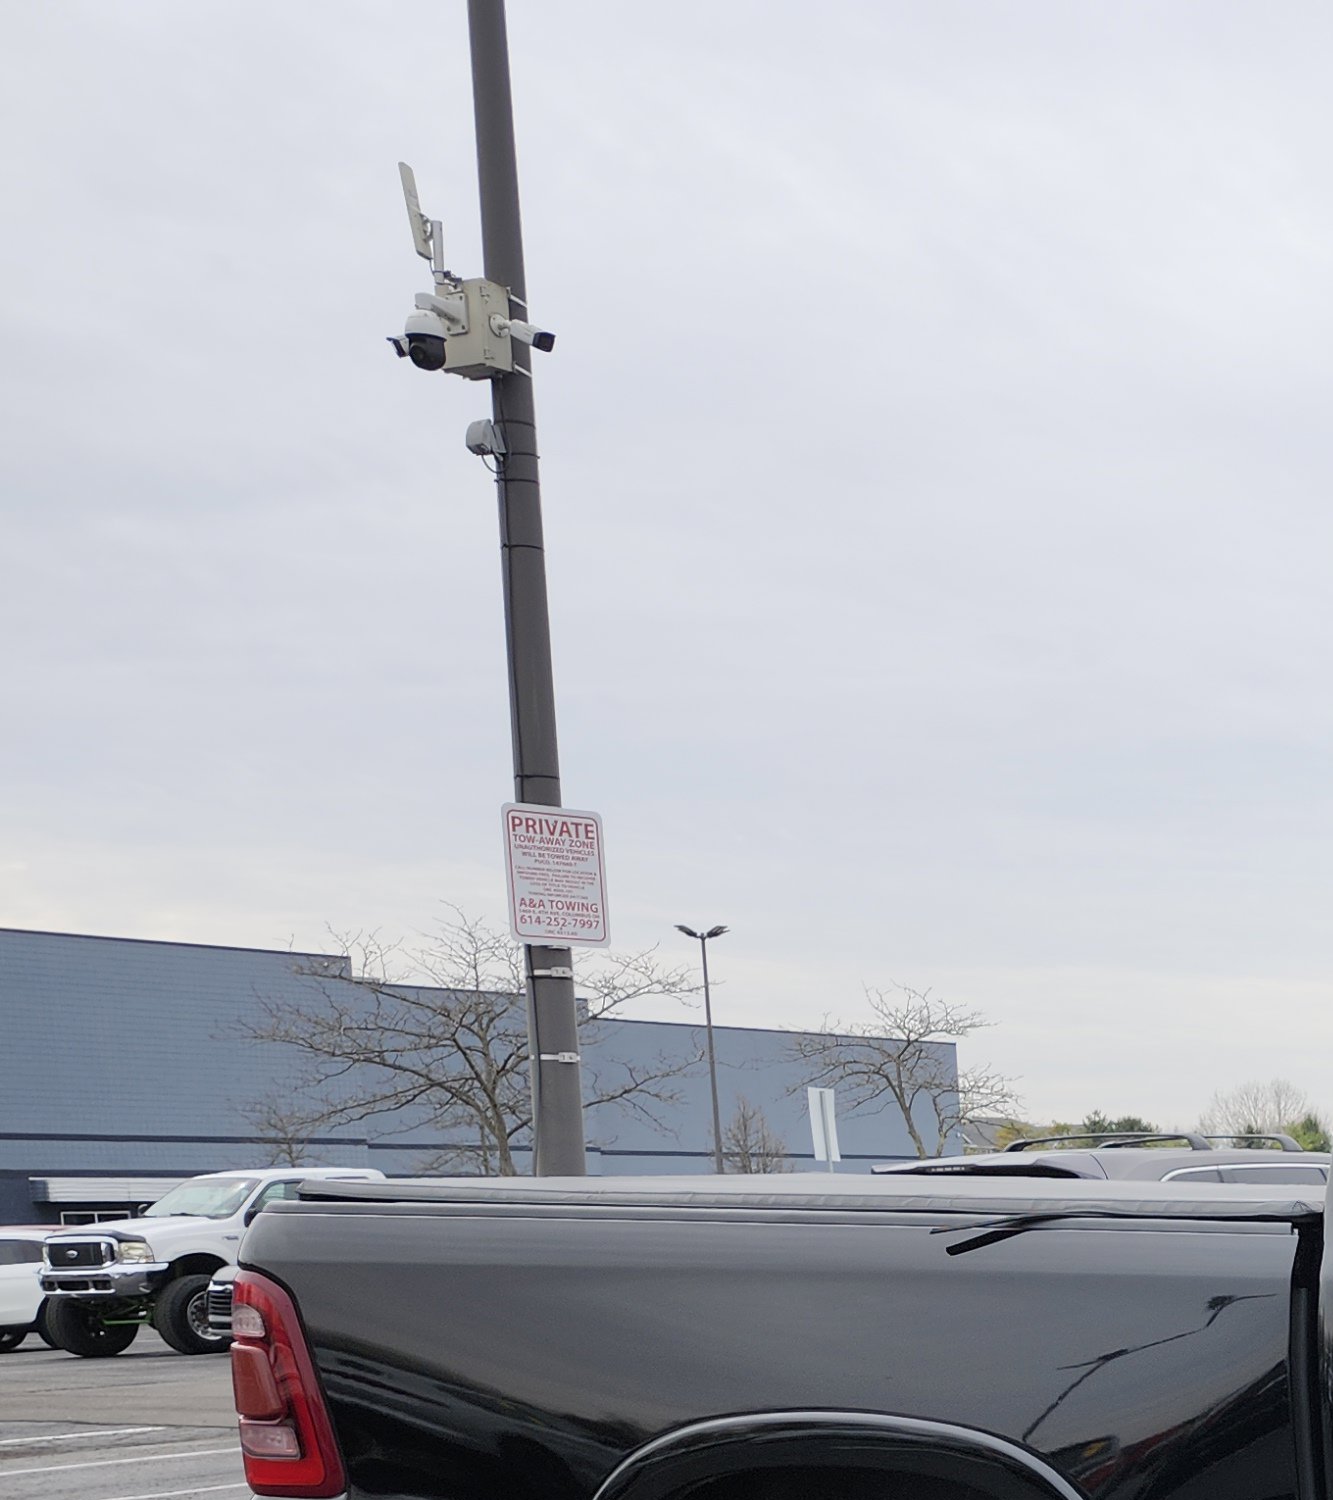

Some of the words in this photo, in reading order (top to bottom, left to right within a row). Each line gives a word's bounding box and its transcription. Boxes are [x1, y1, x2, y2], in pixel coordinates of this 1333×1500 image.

[511, 816, 595, 840] PRIVATE
[513, 834, 566, 846] TOW-AWAY
[569, 839, 595, 850] ZONE
[566, 848, 595, 856] VEHICLES
[519, 897, 546, 909] A&A
[548, 900, 598, 913] TOWING
[520, 914, 599, 929] 614-252-7997
